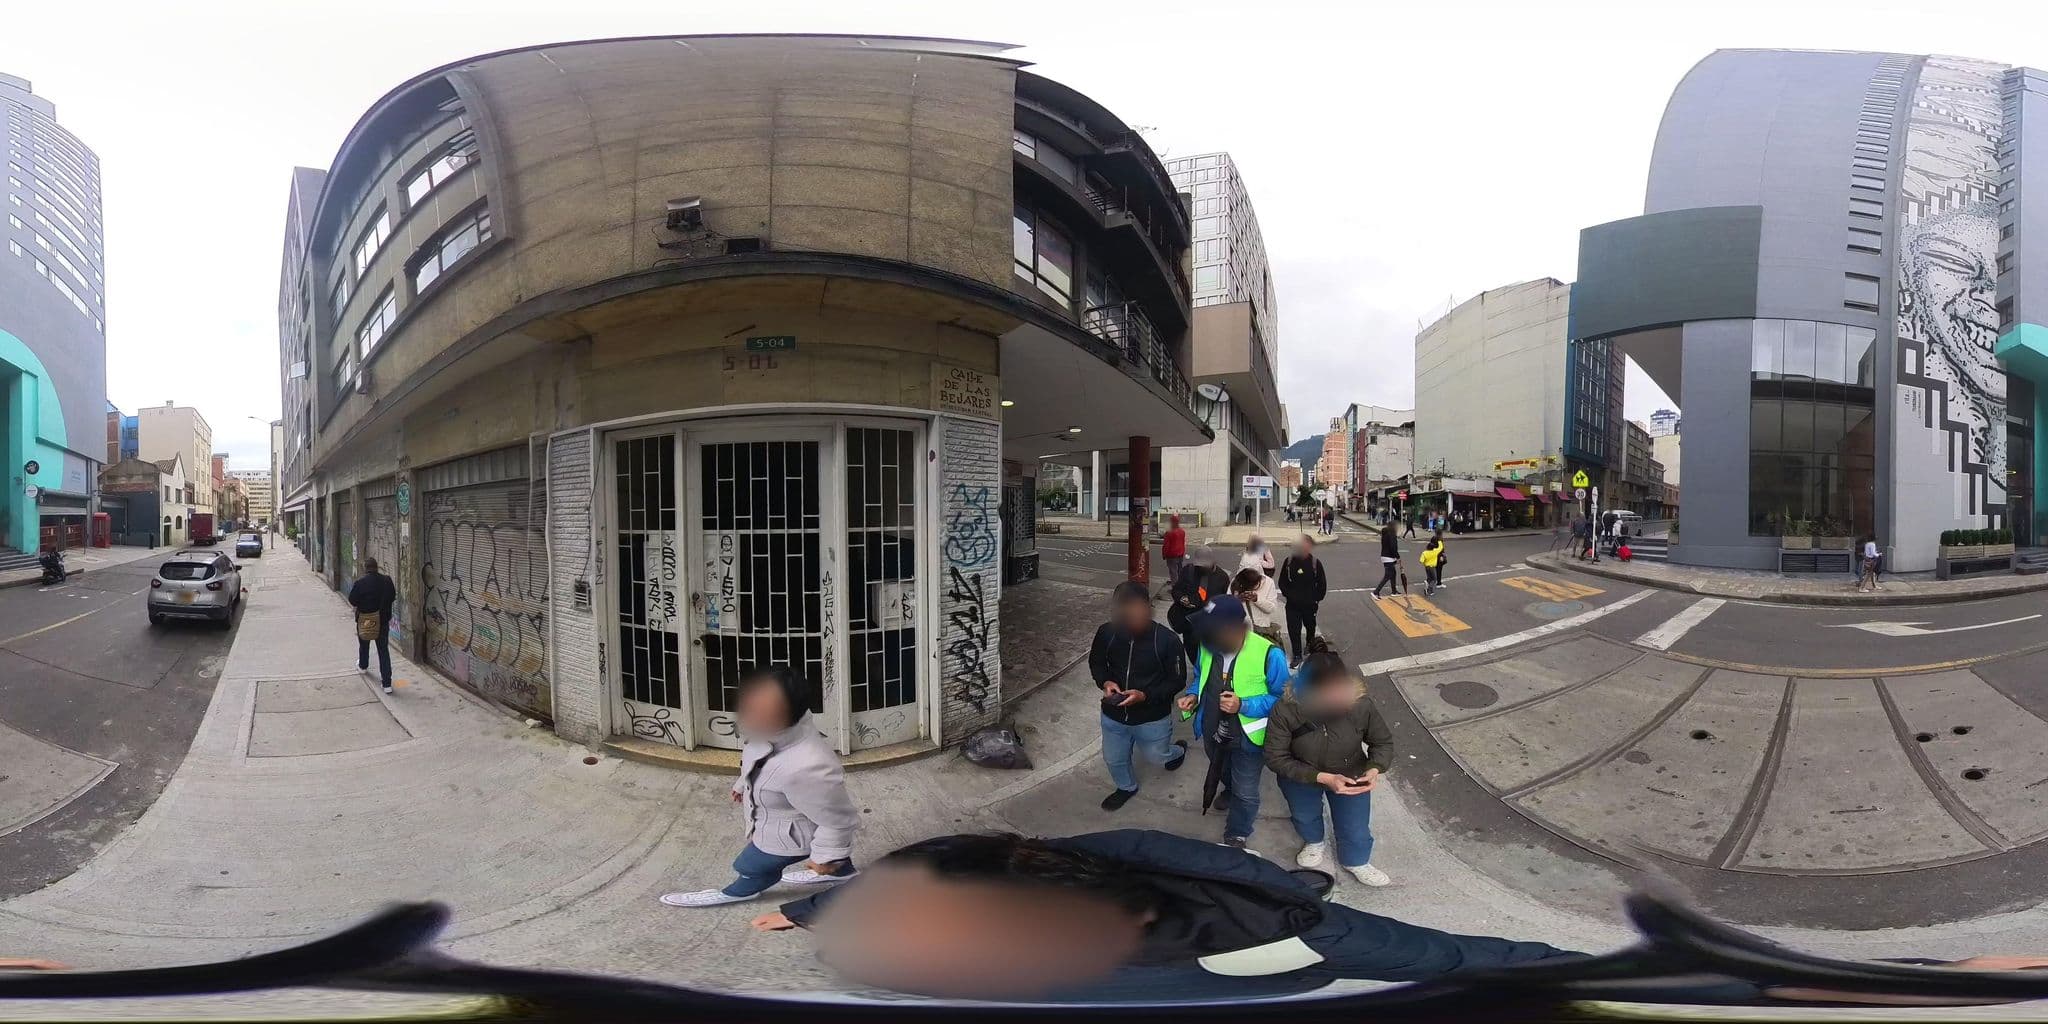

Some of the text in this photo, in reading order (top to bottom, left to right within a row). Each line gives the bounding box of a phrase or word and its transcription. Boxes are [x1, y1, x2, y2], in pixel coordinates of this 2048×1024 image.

[757, 338, 785, 348] 5-04
[951, 368, 983, 384] CALLE
[944, 379, 990, 397] DE LAS
[940, 390, 992, 409] BEJARES
[1576, 490, 1585, 498] 30
